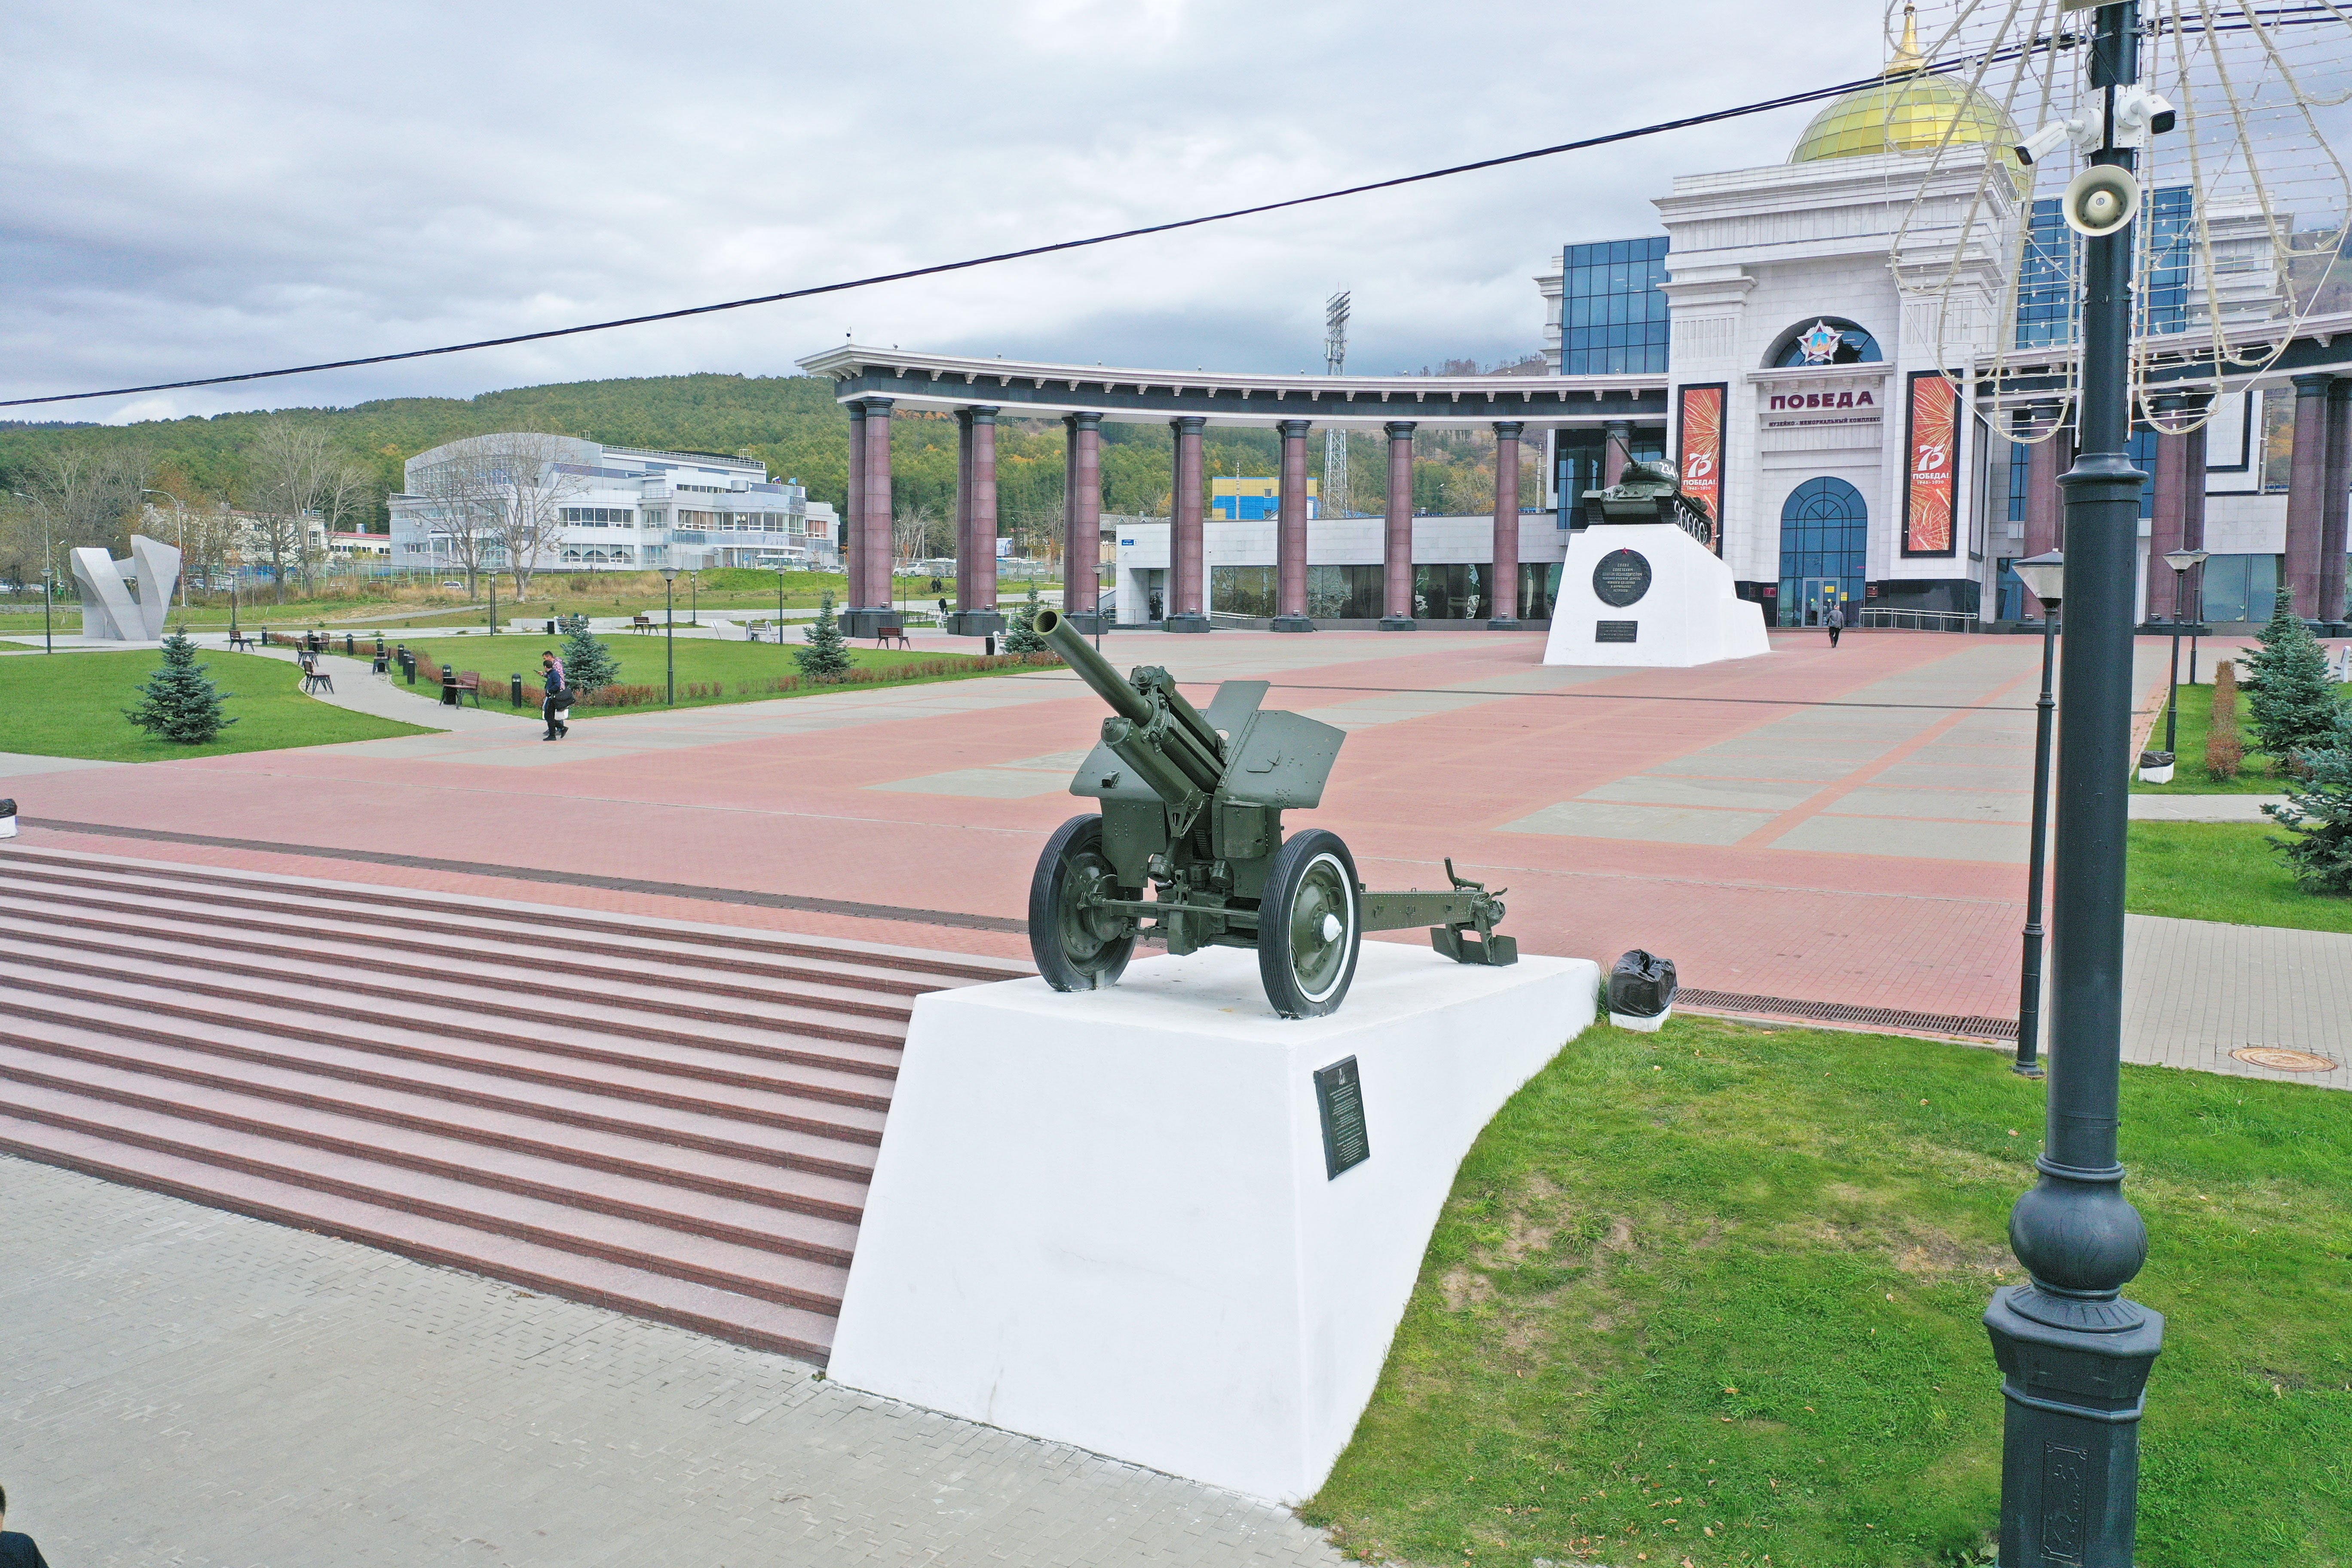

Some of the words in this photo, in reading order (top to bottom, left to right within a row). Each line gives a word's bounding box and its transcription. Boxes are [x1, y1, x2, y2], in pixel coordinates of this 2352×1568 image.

[1770, 391, 1874, 409] ПОБЕДА
[1687, 452, 1712, 478] 75
[1917, 443, 1945, 471] 75
